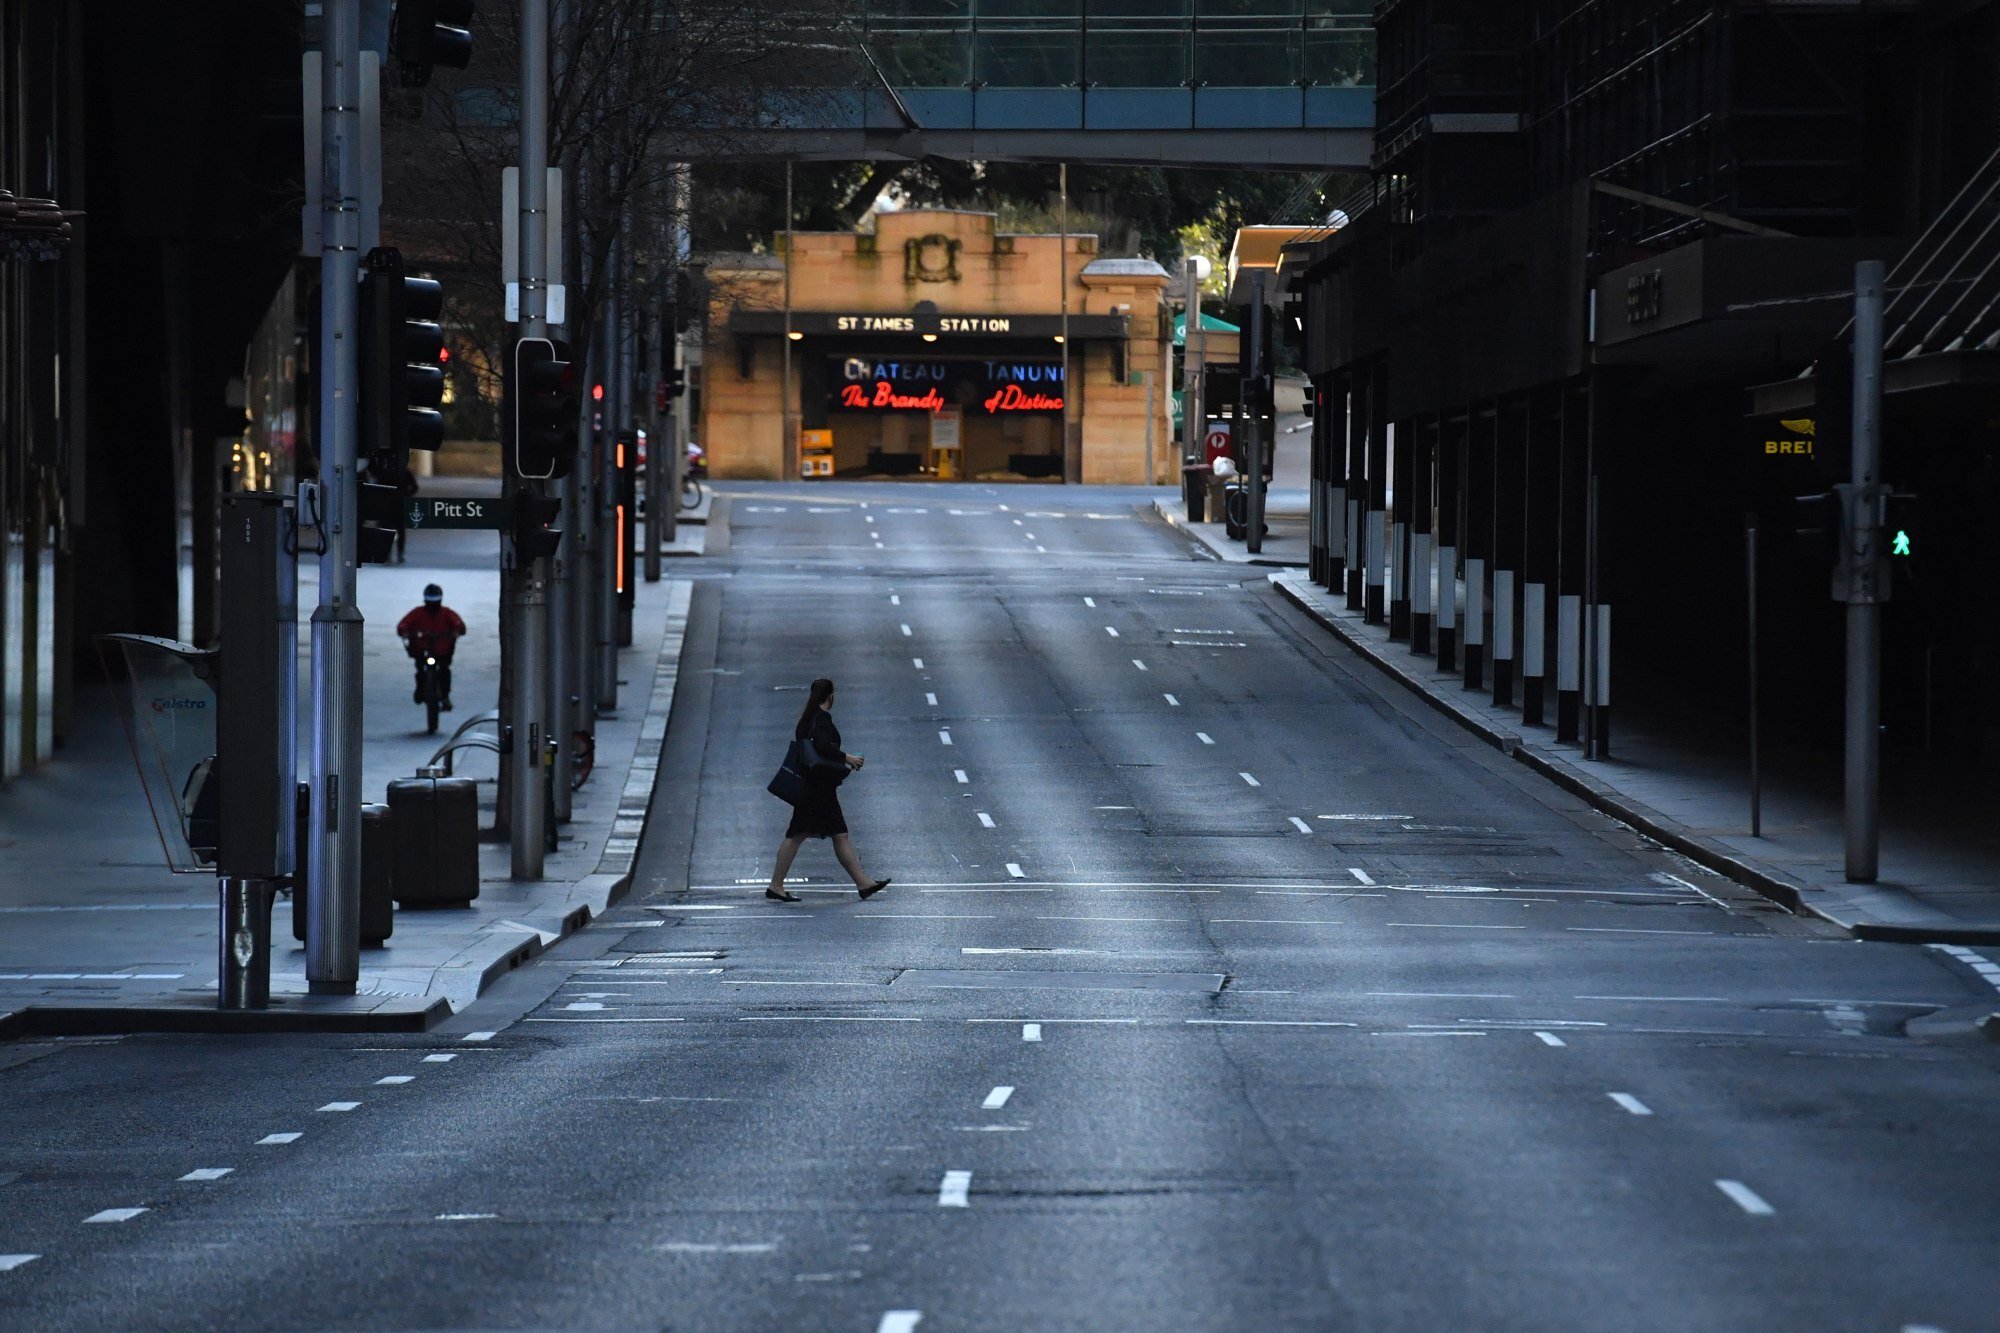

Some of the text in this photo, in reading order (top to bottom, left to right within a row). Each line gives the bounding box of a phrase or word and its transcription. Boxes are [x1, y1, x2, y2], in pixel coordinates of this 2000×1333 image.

[838, 317, 1010, 332] ST JAMES STATION
[844, 358, 945, 380] CHATEAU
[841, 385, 870, 408] The
[872, 381, 944, 415] Brandy
[434, 501, 483, 517] Pitt St
[152, 695, 205, 713] Telstra
